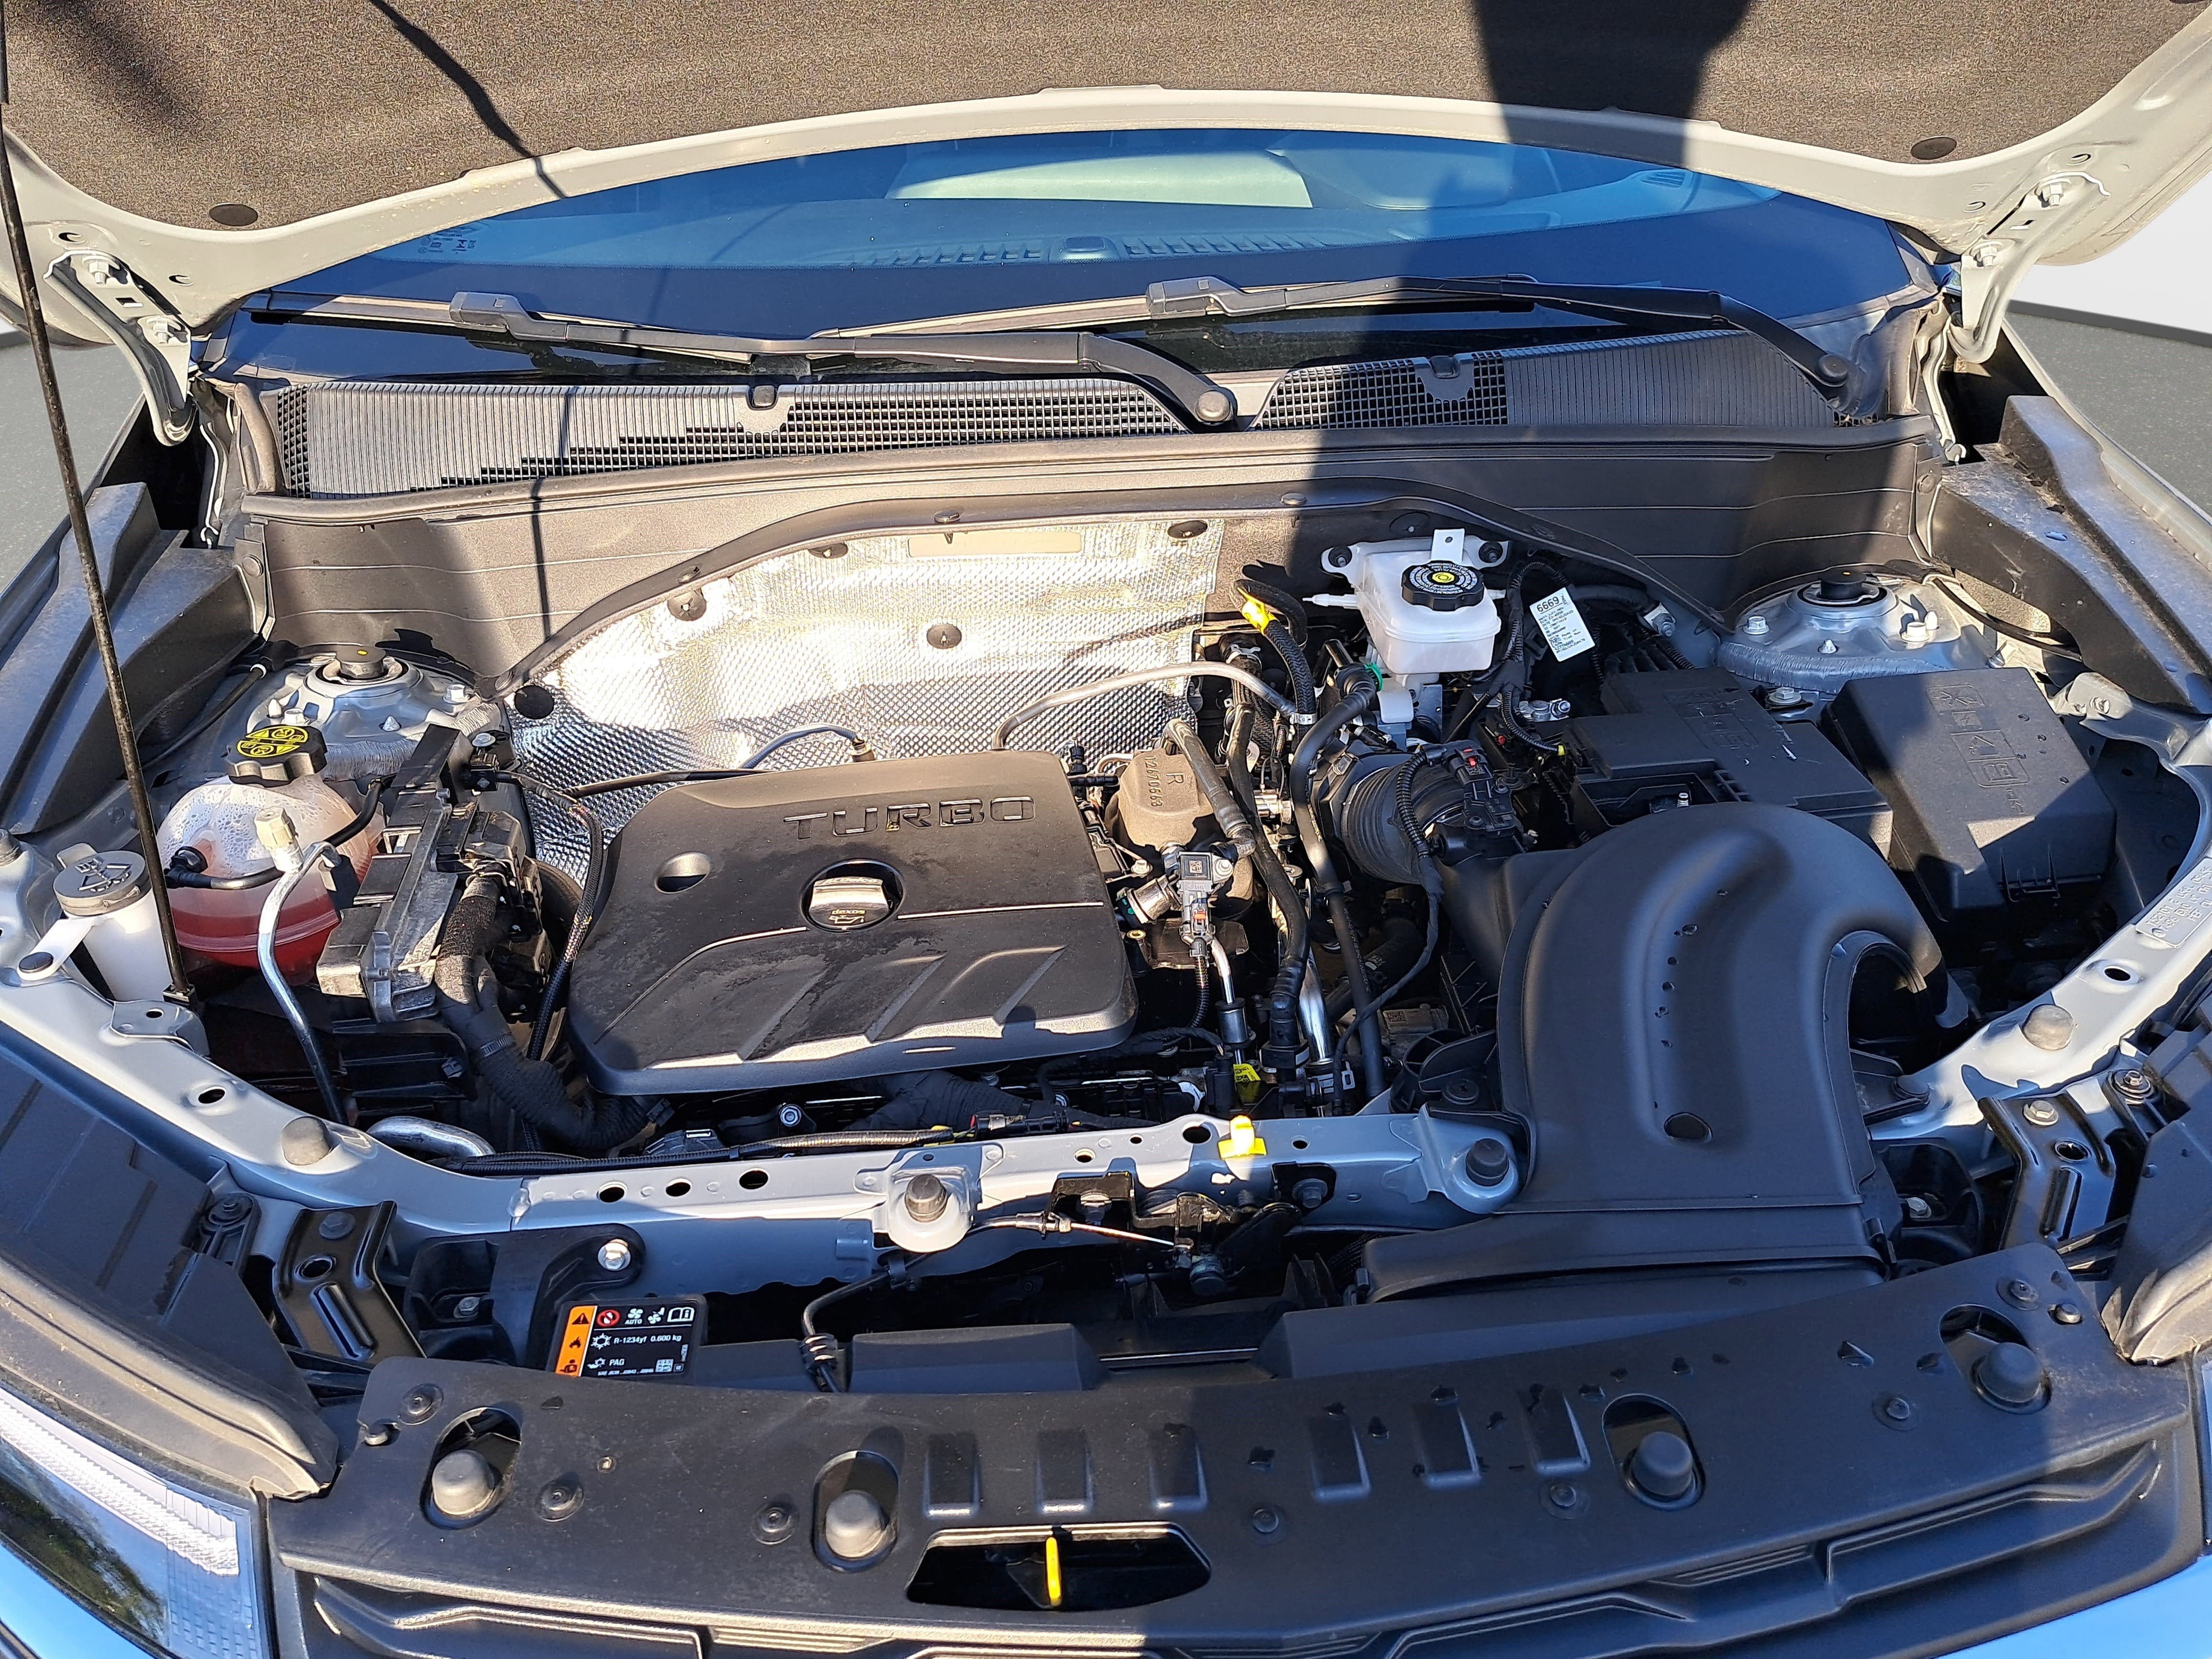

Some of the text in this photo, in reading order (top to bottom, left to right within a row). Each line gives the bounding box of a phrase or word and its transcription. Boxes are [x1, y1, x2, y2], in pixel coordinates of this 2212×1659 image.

[1537, 596, 1559, 612] 6669
[1144, 756, 1163, 807] 12670563
[1166, 773, 1185, 785] R
[783, 796, 1037, 841] TURBO
[672, 1334, 682, 1342] kg
[609, 1358, 625, 1366] PAG
